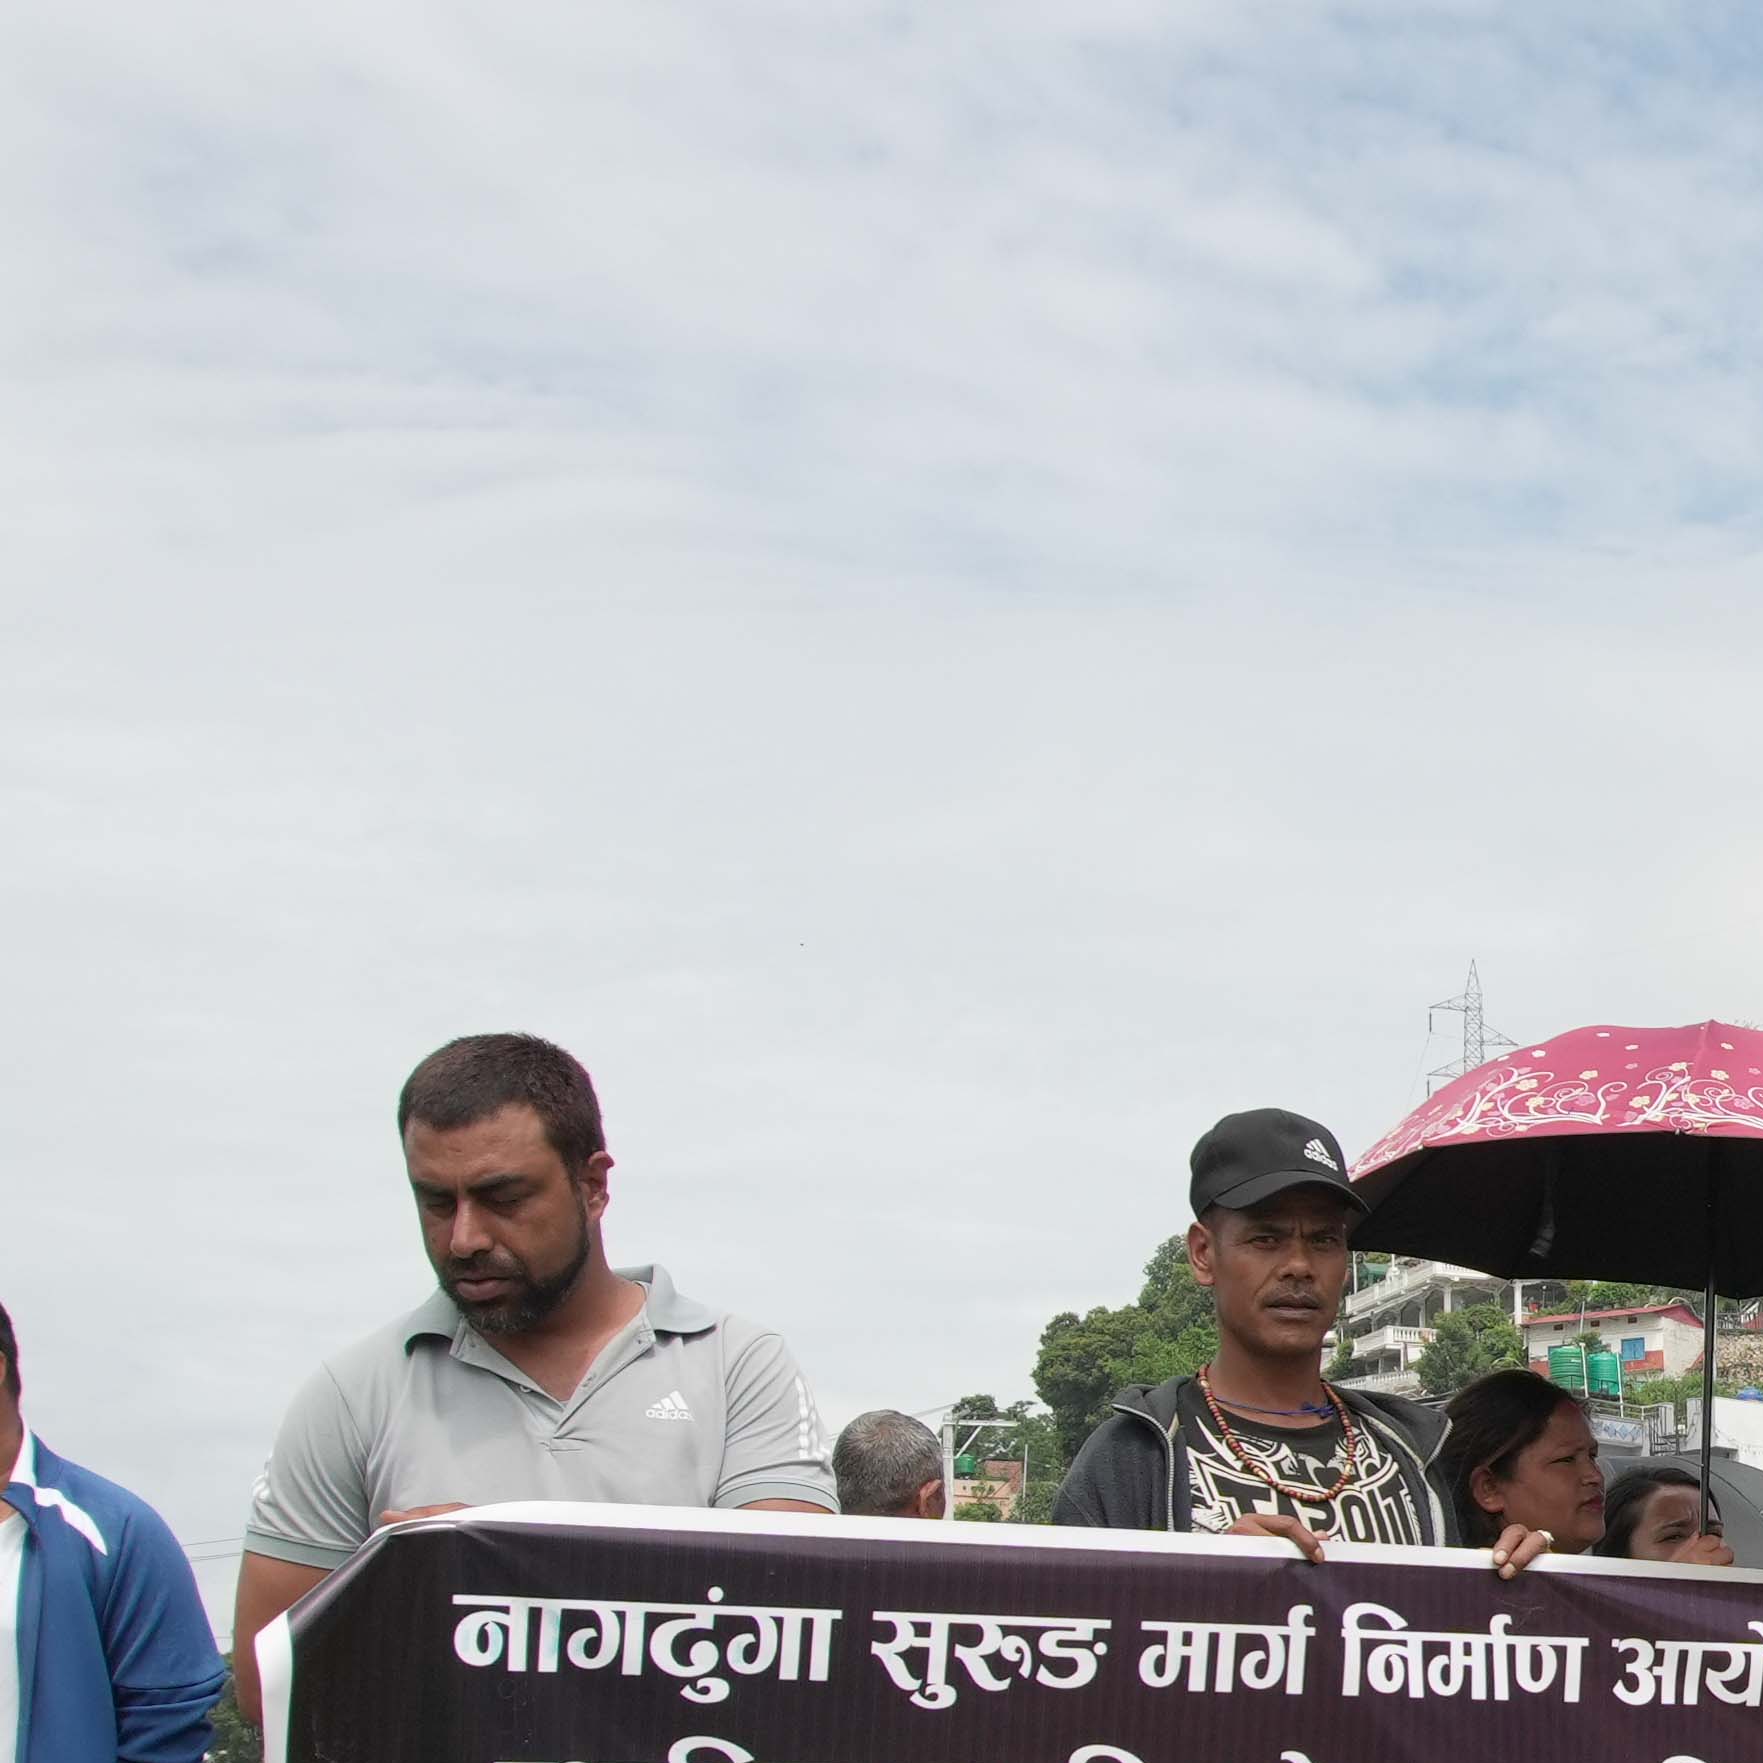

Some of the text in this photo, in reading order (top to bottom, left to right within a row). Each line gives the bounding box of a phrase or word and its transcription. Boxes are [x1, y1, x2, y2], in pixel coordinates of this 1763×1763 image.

[453, 1587, 842, 1703] नागढुंगा
[871, 1611, 1111, 1709] सुरूङ
[1139, 1605, 1315, 1694] मार्ग
[1342, 1603, 1589, 1702] निर्माण
